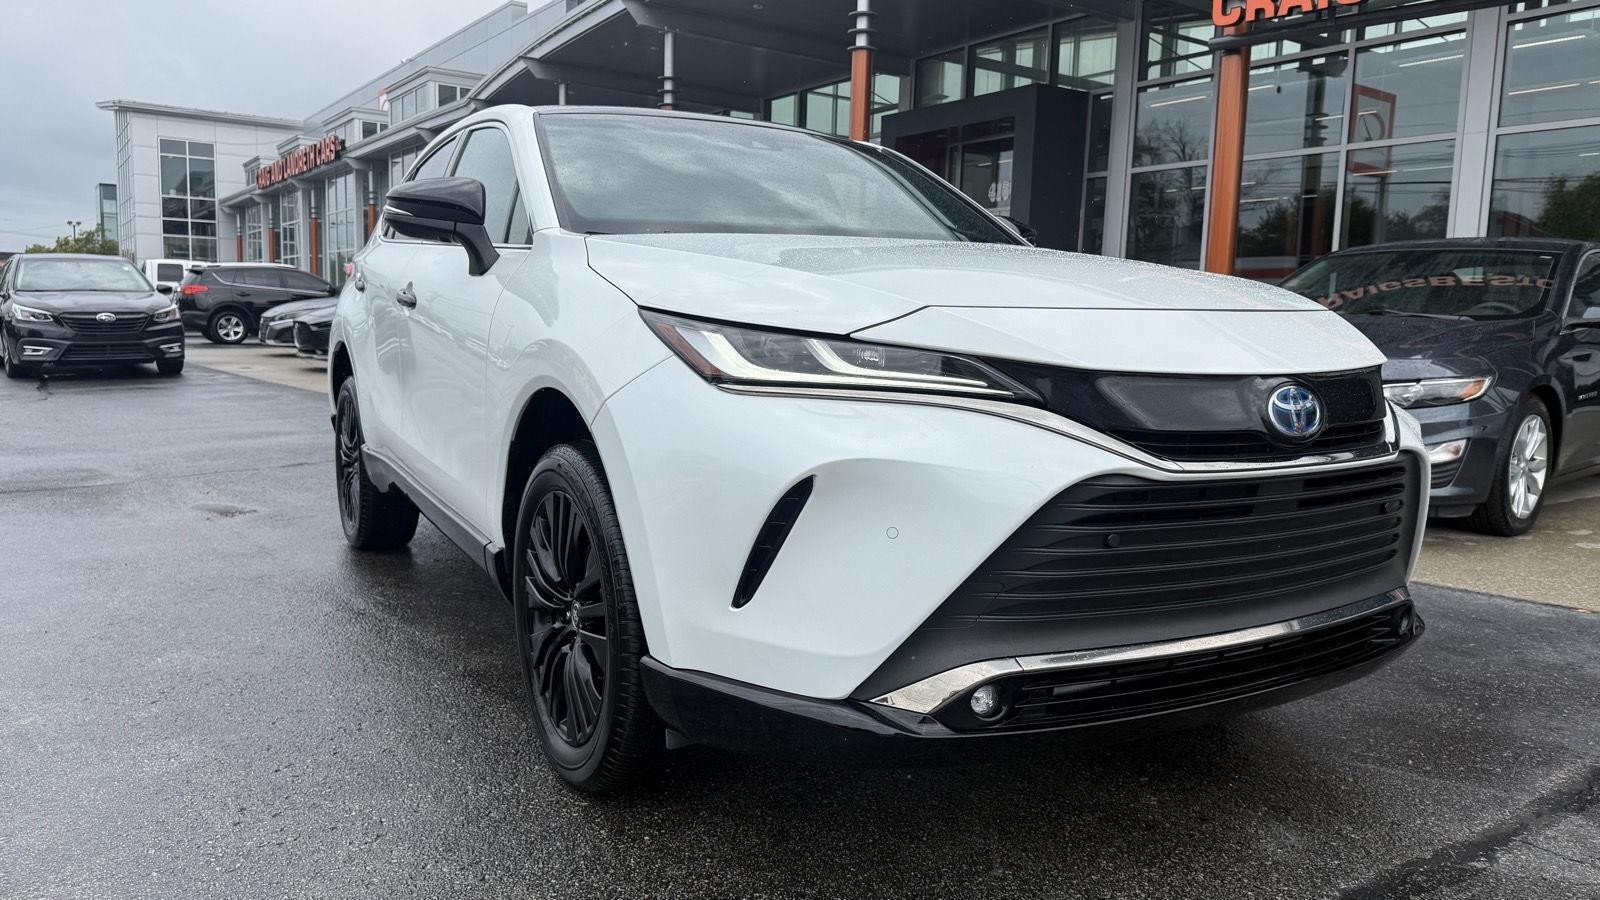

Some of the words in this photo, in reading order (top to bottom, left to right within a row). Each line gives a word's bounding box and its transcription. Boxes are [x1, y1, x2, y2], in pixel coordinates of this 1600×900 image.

[271, 160, 284, 184] AND
[284, 143, 315, 181] LANDRETH
[316, 132, 336, 167] CARS
